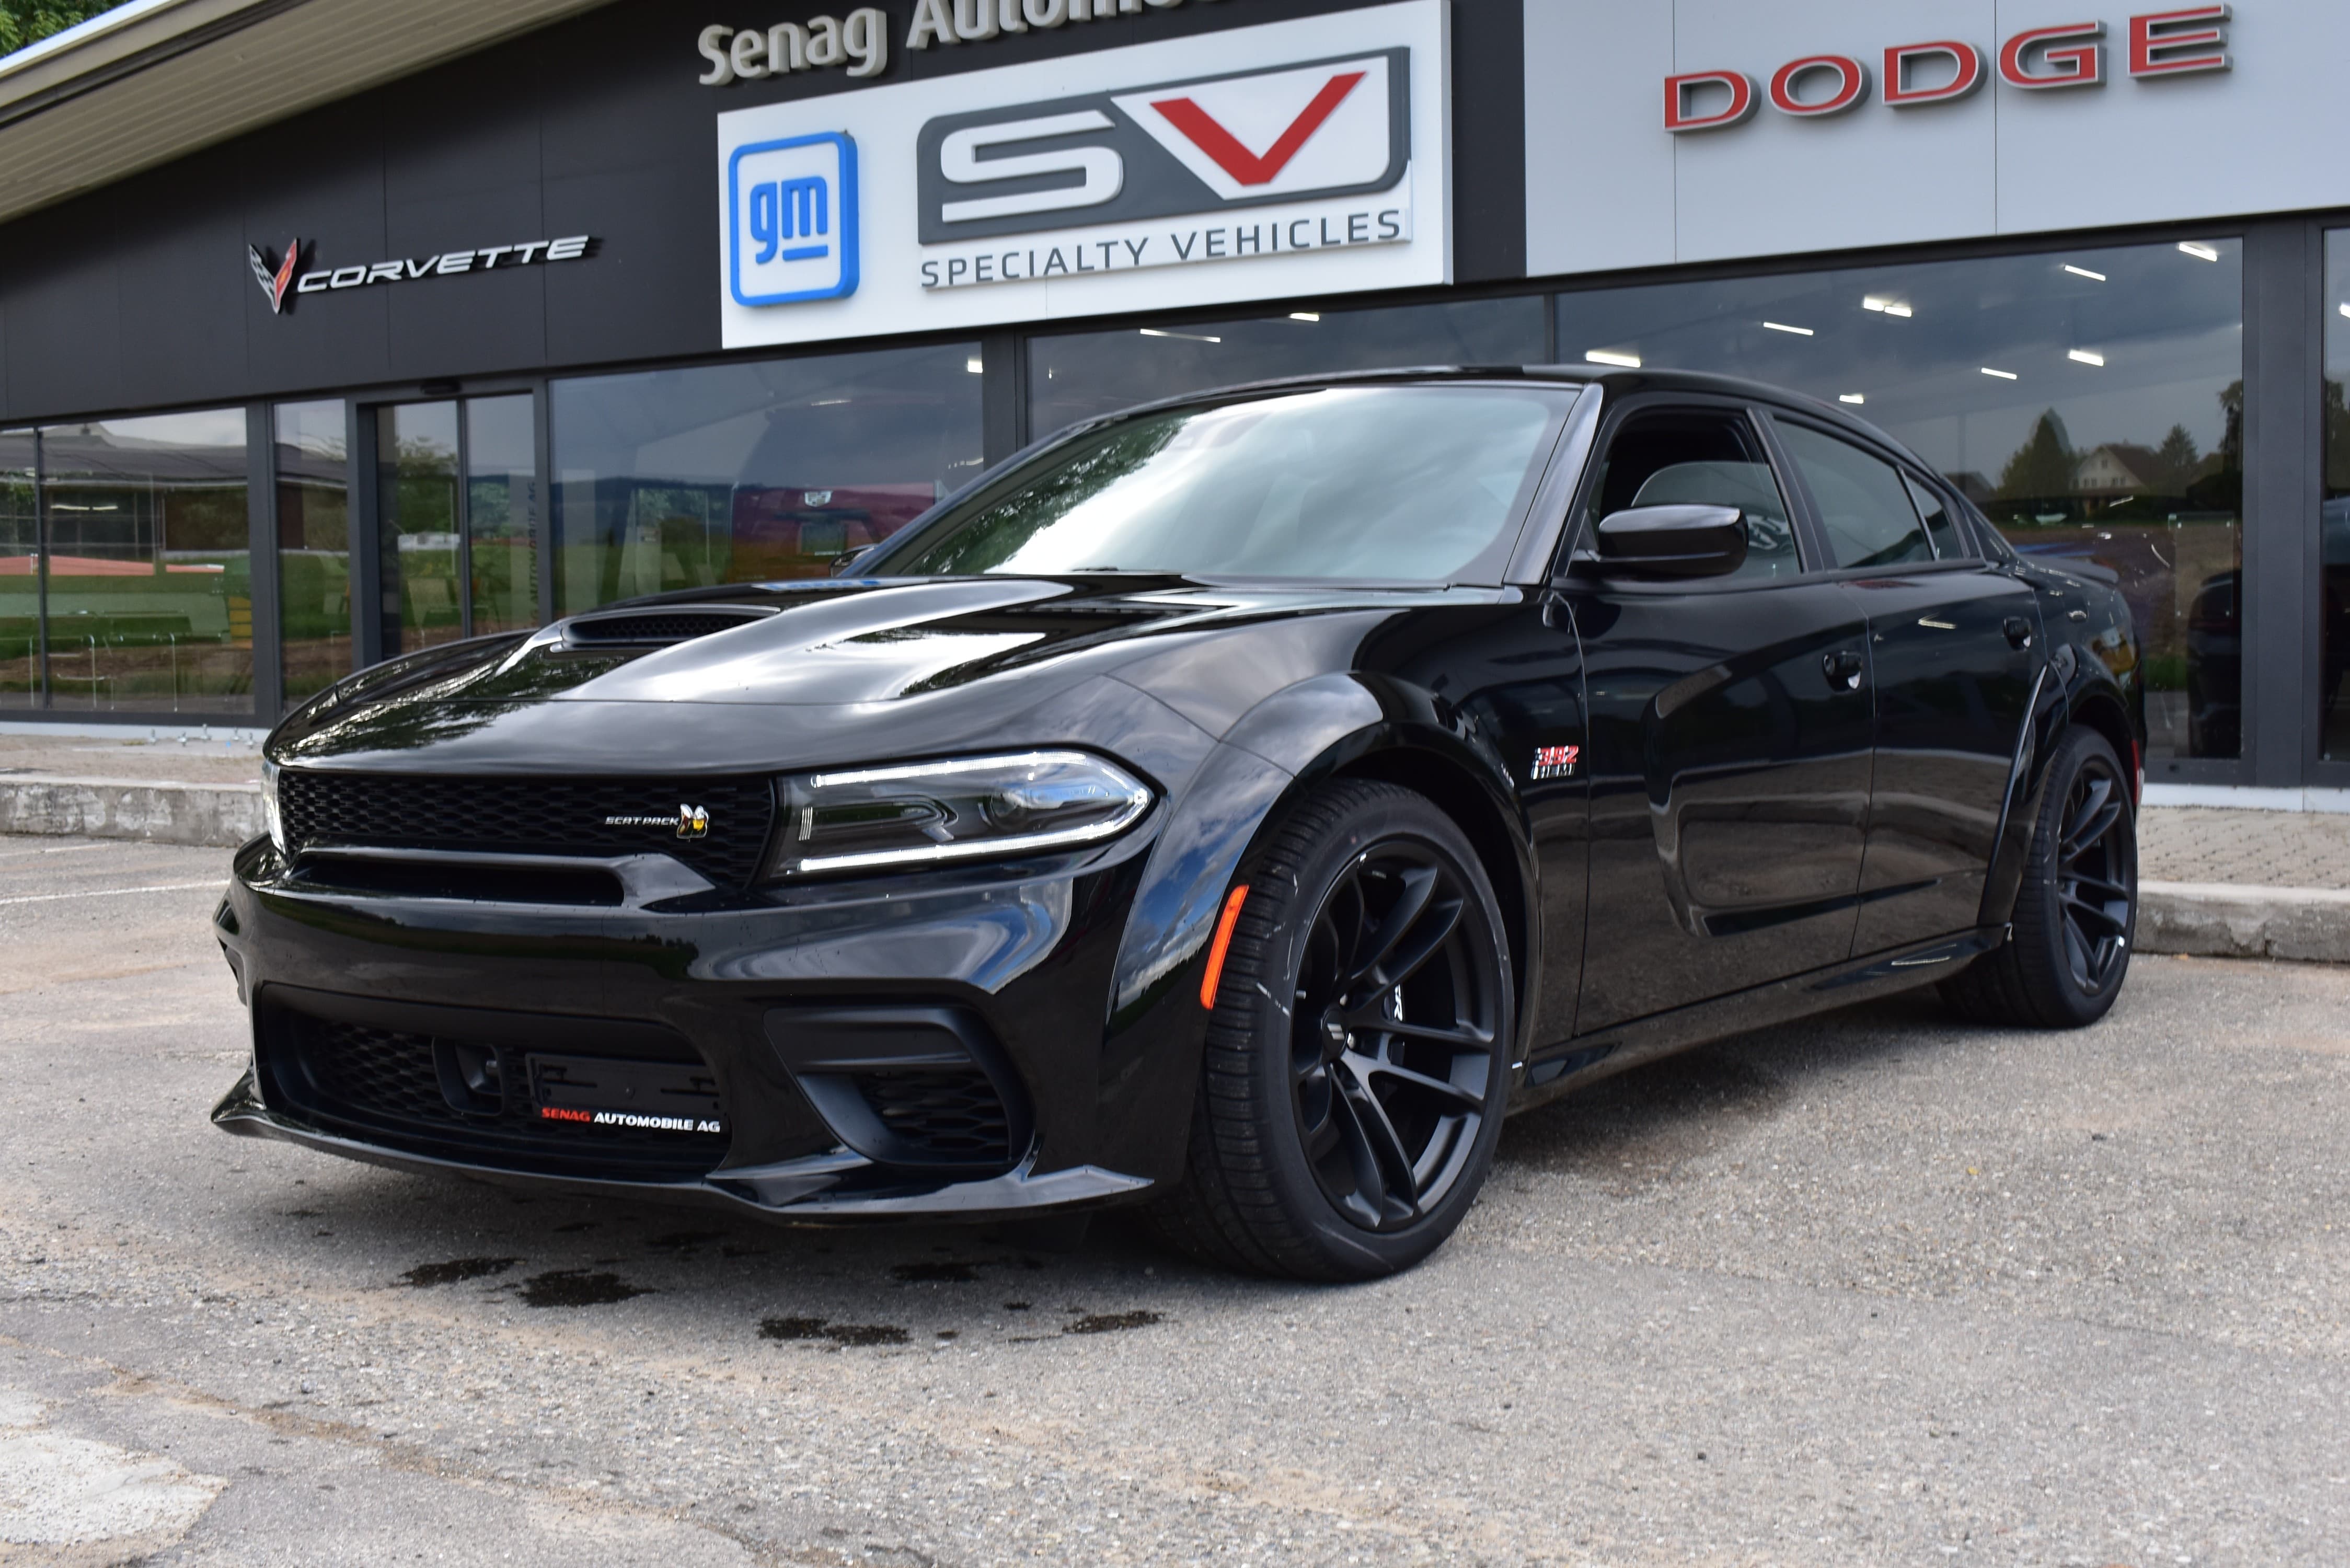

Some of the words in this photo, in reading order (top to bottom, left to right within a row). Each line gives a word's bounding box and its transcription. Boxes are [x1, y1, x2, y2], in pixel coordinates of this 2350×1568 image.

[698, 7, 888, 85] Senag
[1664, 3, 2232, 132] DODGE
[750, 176, 828, 264] gm
[920, 236, 1149, 286] SPECIALTY
[1170, 210, 1400, 260] VEHICLES
[297, 236, 589, 293] CORVETTE
[605, 816, 642, 825] SCAT
[642, 816, 678, 825] PACK
[542, 1107, 591, 1122] SENAG
[594, 1112, 694, 1131] AUTOMOBILE
[697, 1121, 721, 1133] AG
